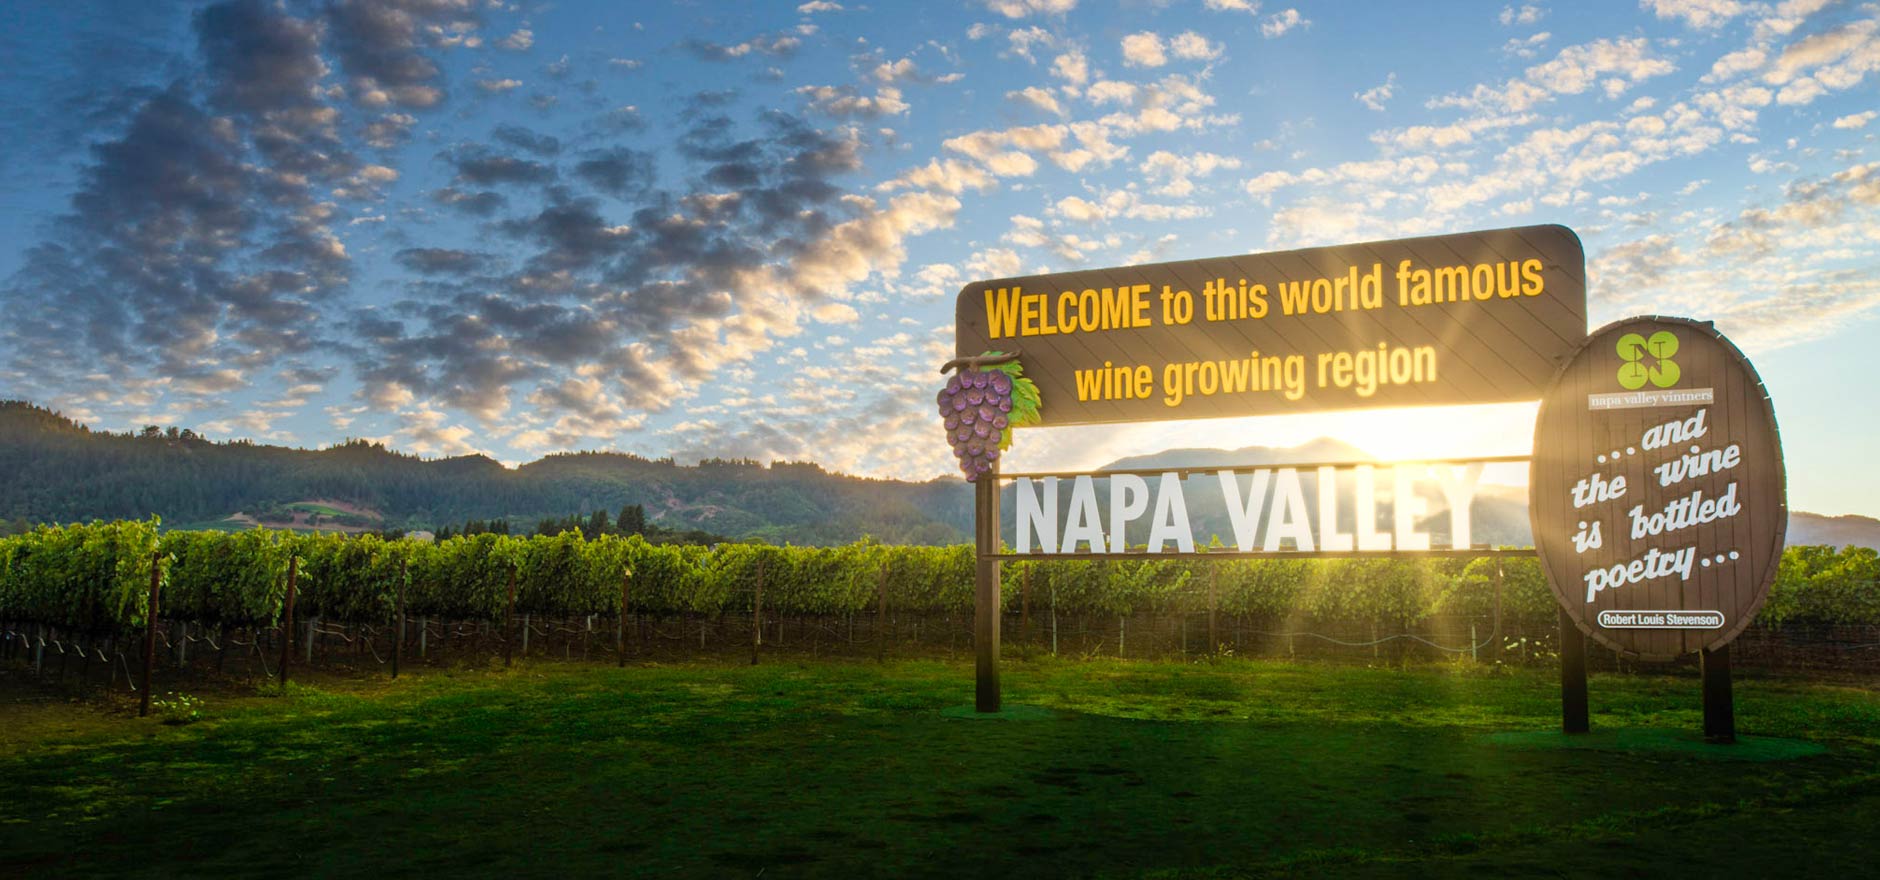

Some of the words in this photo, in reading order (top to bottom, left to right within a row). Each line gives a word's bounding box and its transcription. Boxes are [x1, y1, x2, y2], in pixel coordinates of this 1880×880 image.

[985, 285, 1151, 338] WELCOME
[1161, 285, 1193, 324] to
[1203, 278, 1268, 322] this
[1279, 263, 1383, 314] world
[1397, 258, 1544, 307] famous
[1075, 361, 1153, 402] wine
[1163, 351, 1305, 407] growing
[1318, 342, 1437, 396] region
[1591, 395, 1621, 408] napa
[1624, 392, 1659, 407] valley
[1661, 389, 1713, 402] vintners
[1571, 473, 1626, 508] the
[1654, 444, 1740, 487] wine
[1017, 472, 1196, 554] NAPA
[1219, 464, 1484, 551] VALLEY
[1572, 521, 1602, 553] is
[1628, 482, 1741, 540] bottled
[1603, 614, 1636, 625] Robert
[1638, 614, 1664, 625] Louis
[1667, 614, 1718, 625] Stevenson
